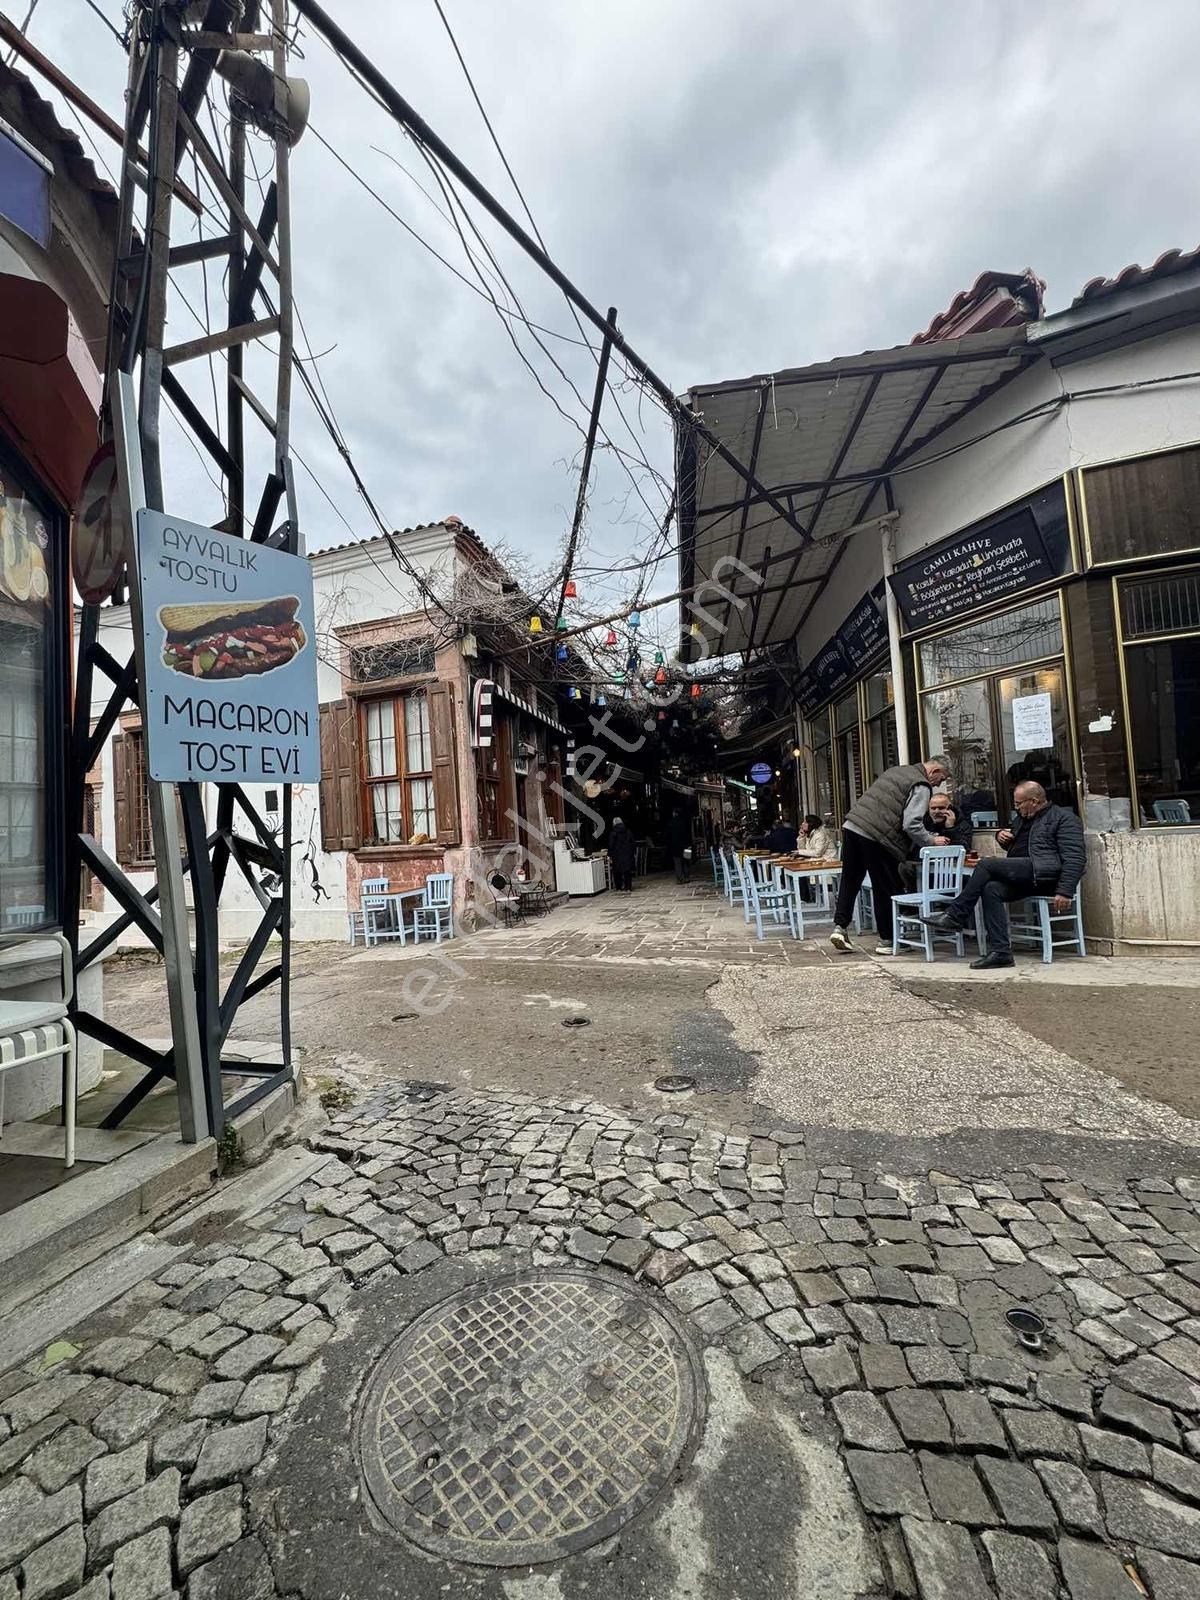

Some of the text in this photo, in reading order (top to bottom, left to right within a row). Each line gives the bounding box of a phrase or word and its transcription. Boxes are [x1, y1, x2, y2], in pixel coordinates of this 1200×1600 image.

[163, 527, 258, 572] AYVALIK
[953, 538, 992, 557] KAHVE
[162, 555, 238, 593] TOSTU
[164, 694, 309, 736] MACARON
[180, 741, 300, 774] TOST EVİ
